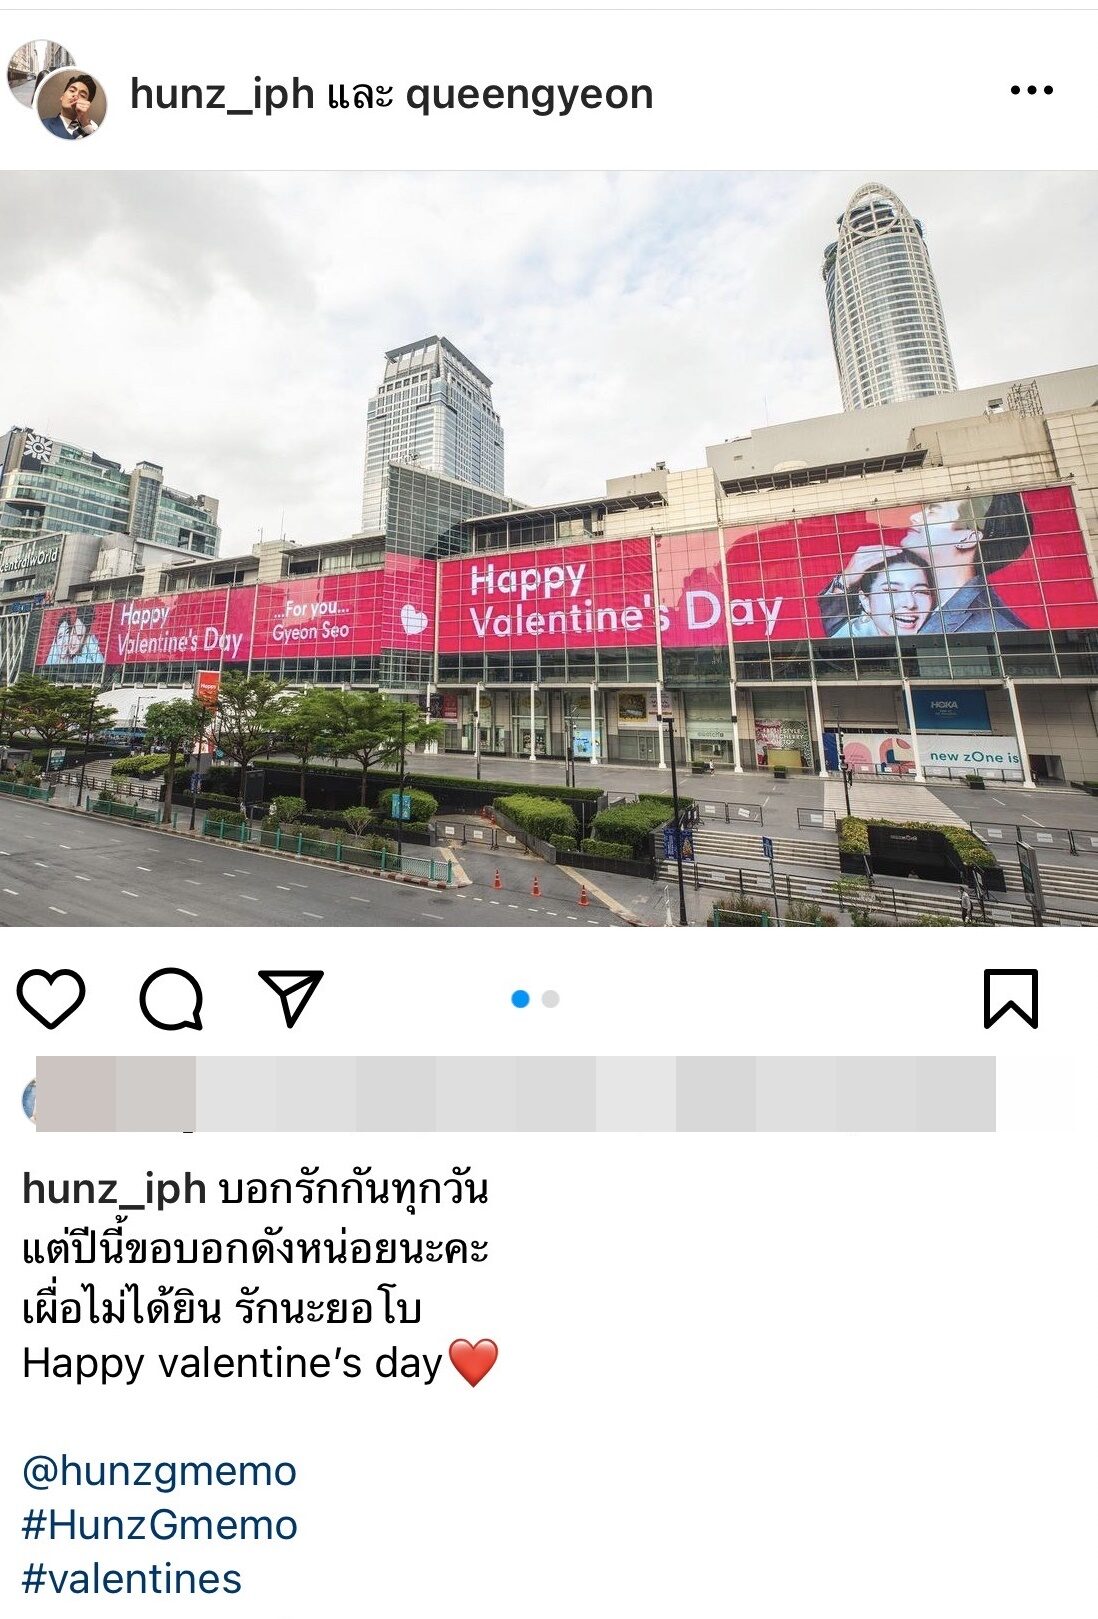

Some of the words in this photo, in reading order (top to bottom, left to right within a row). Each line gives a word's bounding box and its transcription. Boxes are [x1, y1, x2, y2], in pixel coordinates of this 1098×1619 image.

[471, 563, 586, 599] Happy
[120, 603, 170, 631] Happy
[469, 593, 670, 638] Valentine's
[687, 590, 784, 636] Day
[117, 628, 198, 656] Valentine's
[203, 627, 244, 659] Day
[272, 623, 317, 645] Gyeon
[321, 620, 350, 639] Seo
[930, 701, 959, 710] HOKA
[930, 751, 959, 762] new
[1006, 752, 1019, 763] is
